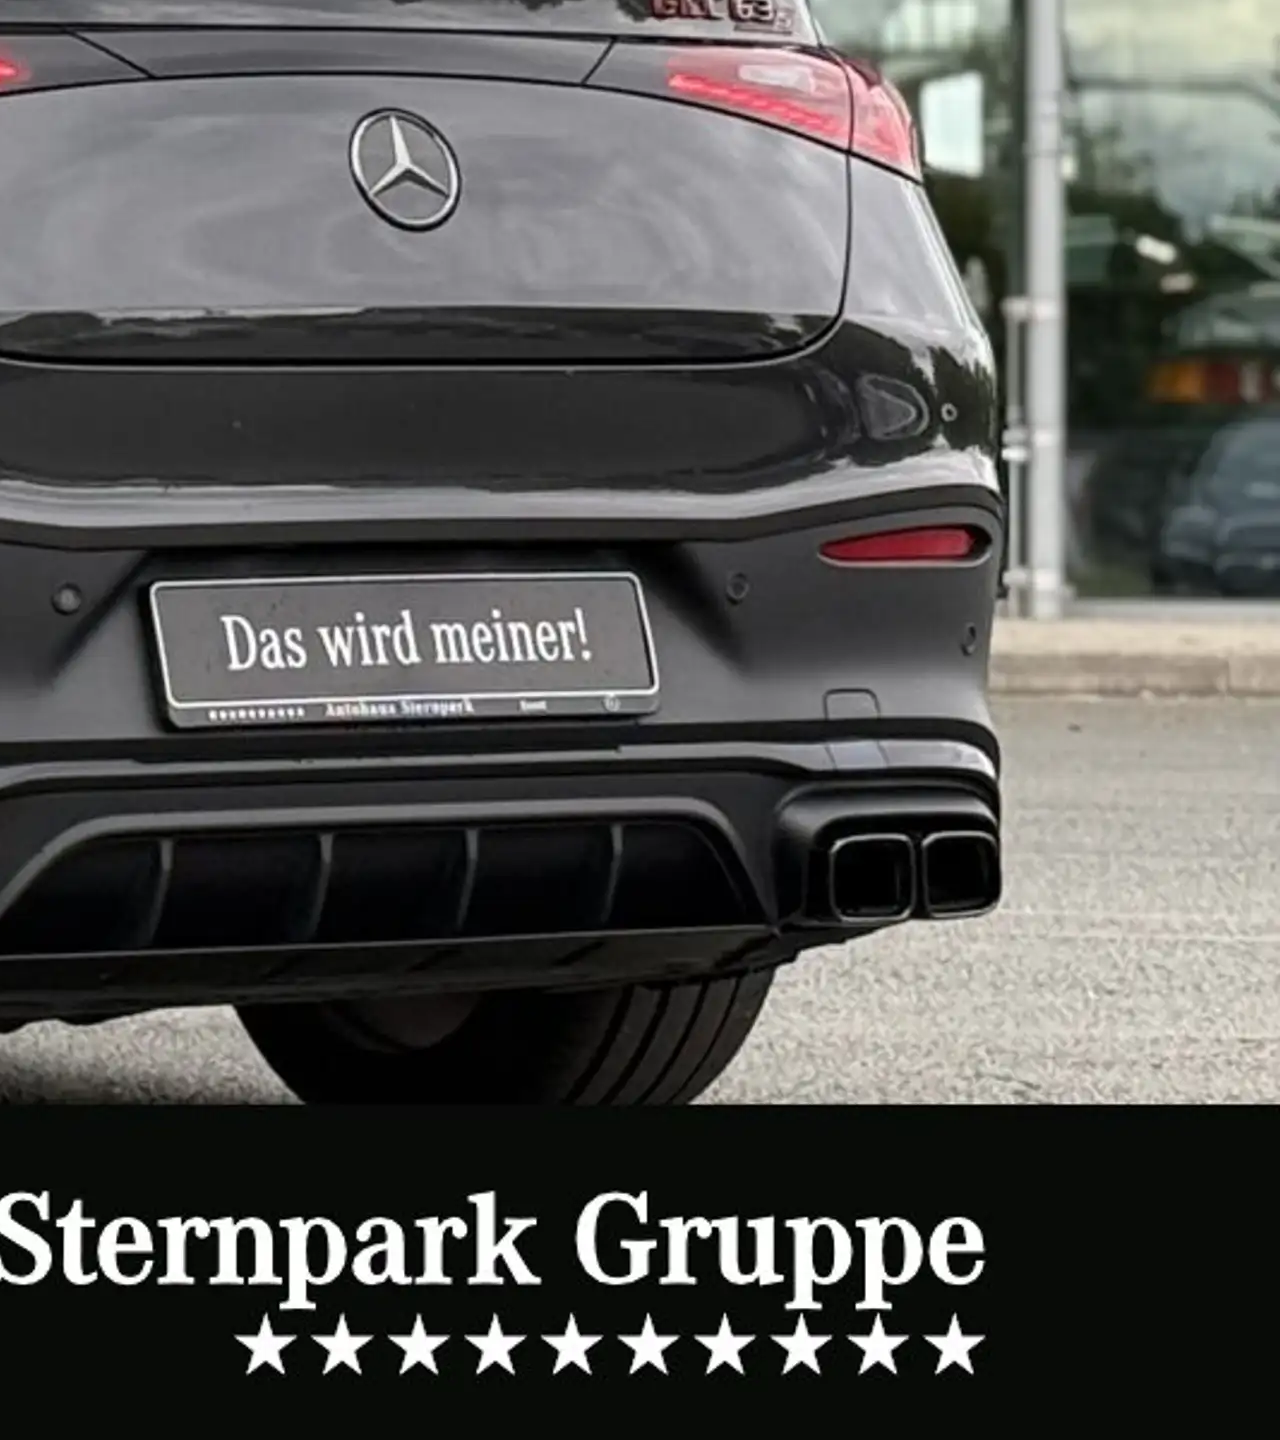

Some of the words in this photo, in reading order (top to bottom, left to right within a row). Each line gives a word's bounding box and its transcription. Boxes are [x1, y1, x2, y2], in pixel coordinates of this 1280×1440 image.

[220, 614, 307, 671] Das
[316, 609, 422, 668] wird
[429, 606, 593, 664] meiner!
